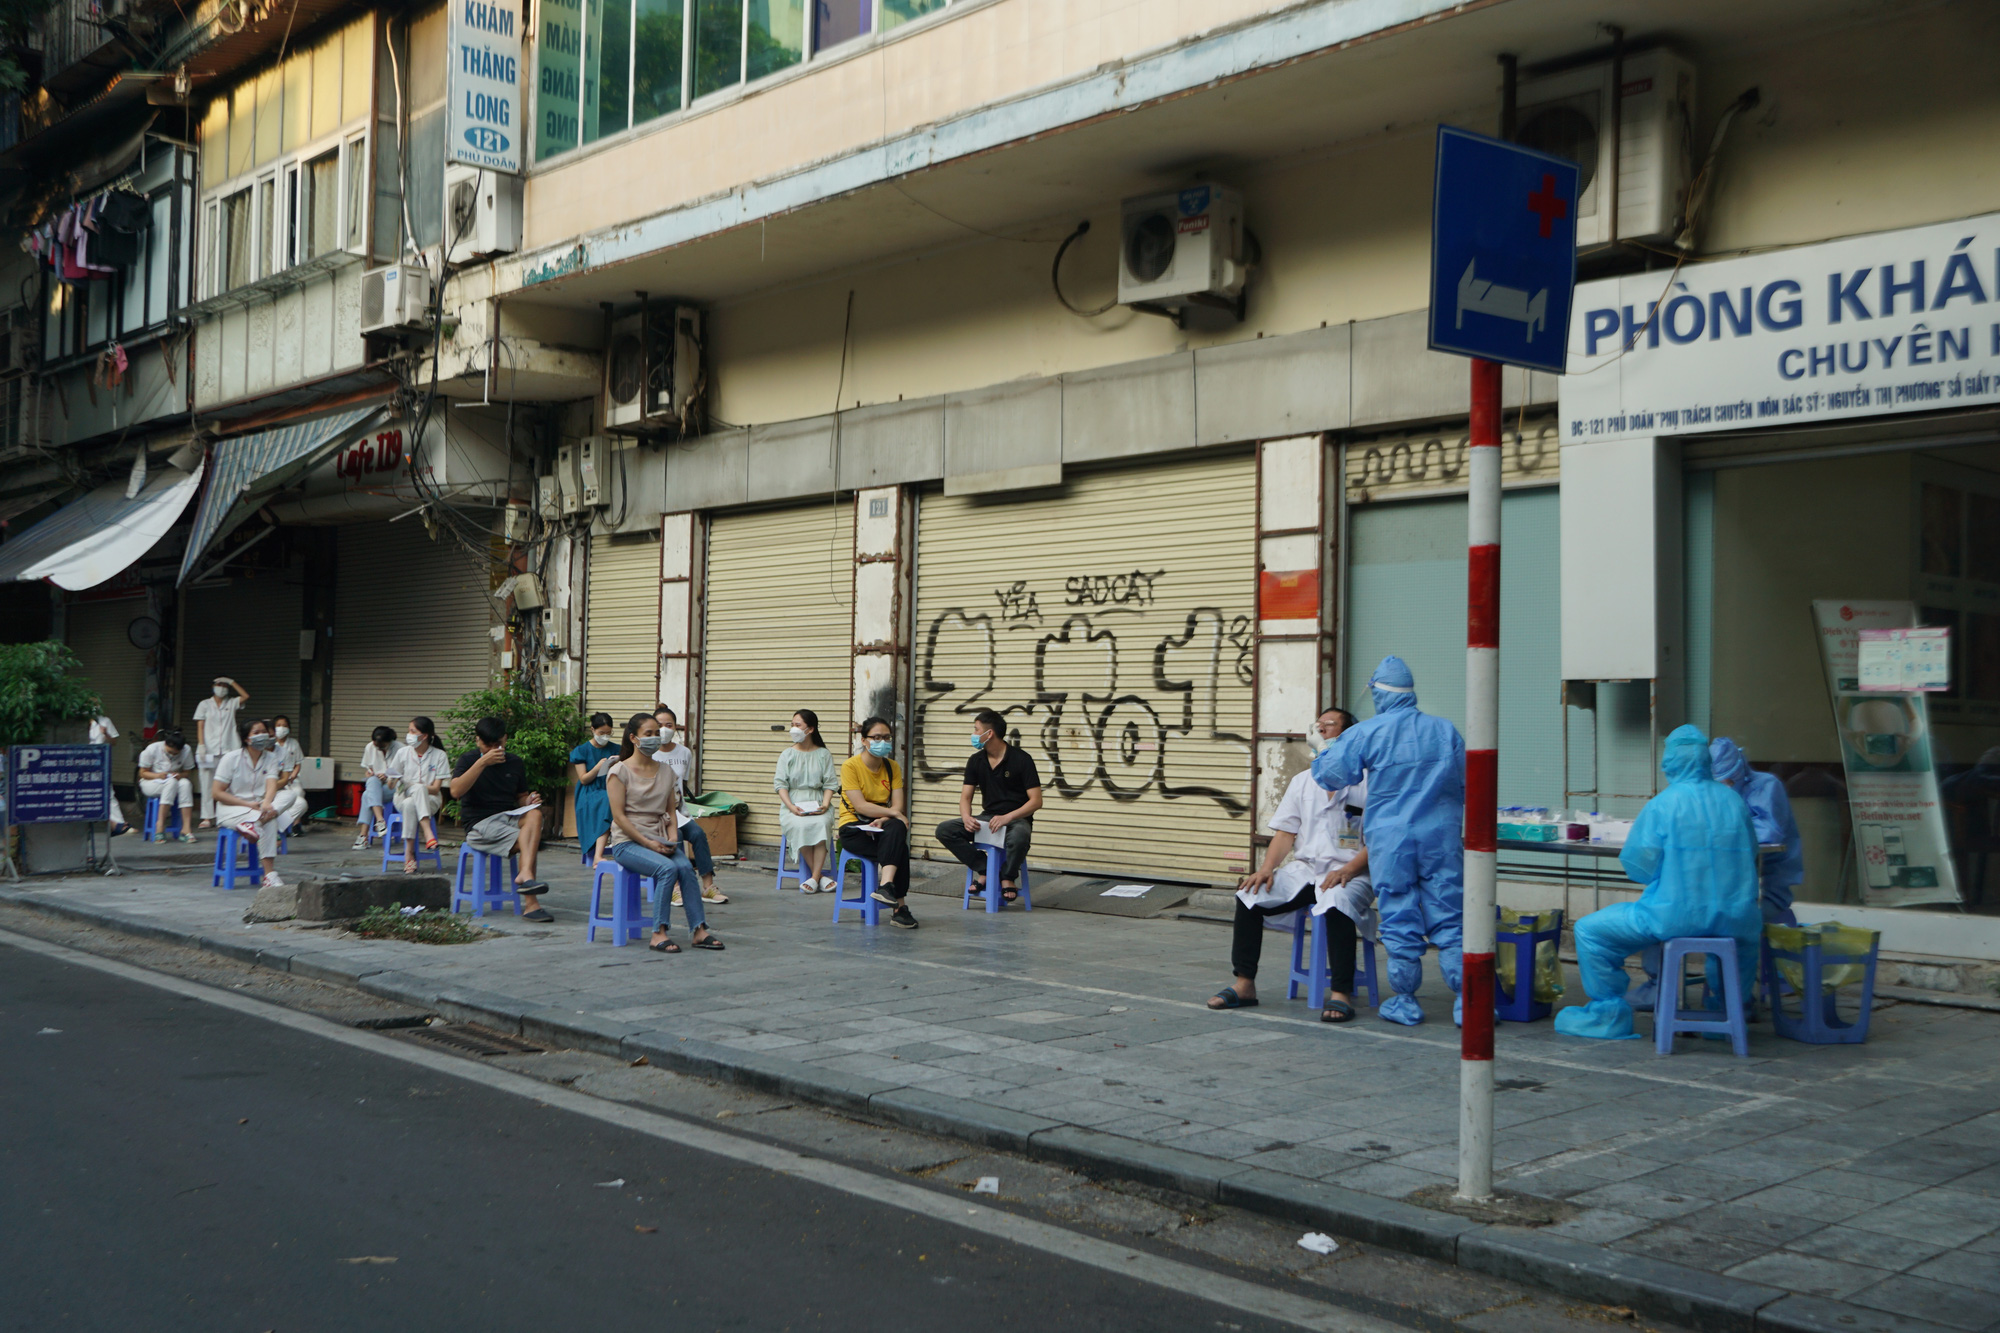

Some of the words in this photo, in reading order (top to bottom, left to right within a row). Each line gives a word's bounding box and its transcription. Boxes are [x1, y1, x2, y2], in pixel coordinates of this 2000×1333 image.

[465, 0, 514, 38] KHÁM
[461, 45, 516, 86] THĂNG
[466, 90, 510, 128] LONG
[474, 129, 502, 153] 121
[1584, 280, 1803, 358] PHÒNG
[1827, 234, 2000, 326] KHÁ
[1777, 323, 1970, 381] CHUYÊN
[1589, 418, 1604, 435] 121
[1681, 403, 1712, 426] TRÁCH
[1714, 399, 1753, 422] CHUYÊN
[1757, 396, 1779, 418] MÔN
[1783, 394, 1802, 415] BÁC
[1874, 386, 1893, 409] THỊ
[375, 429, 402, 472] 119
[872, 502, 885, 515] 121
[20, 749, 41, 769] P
